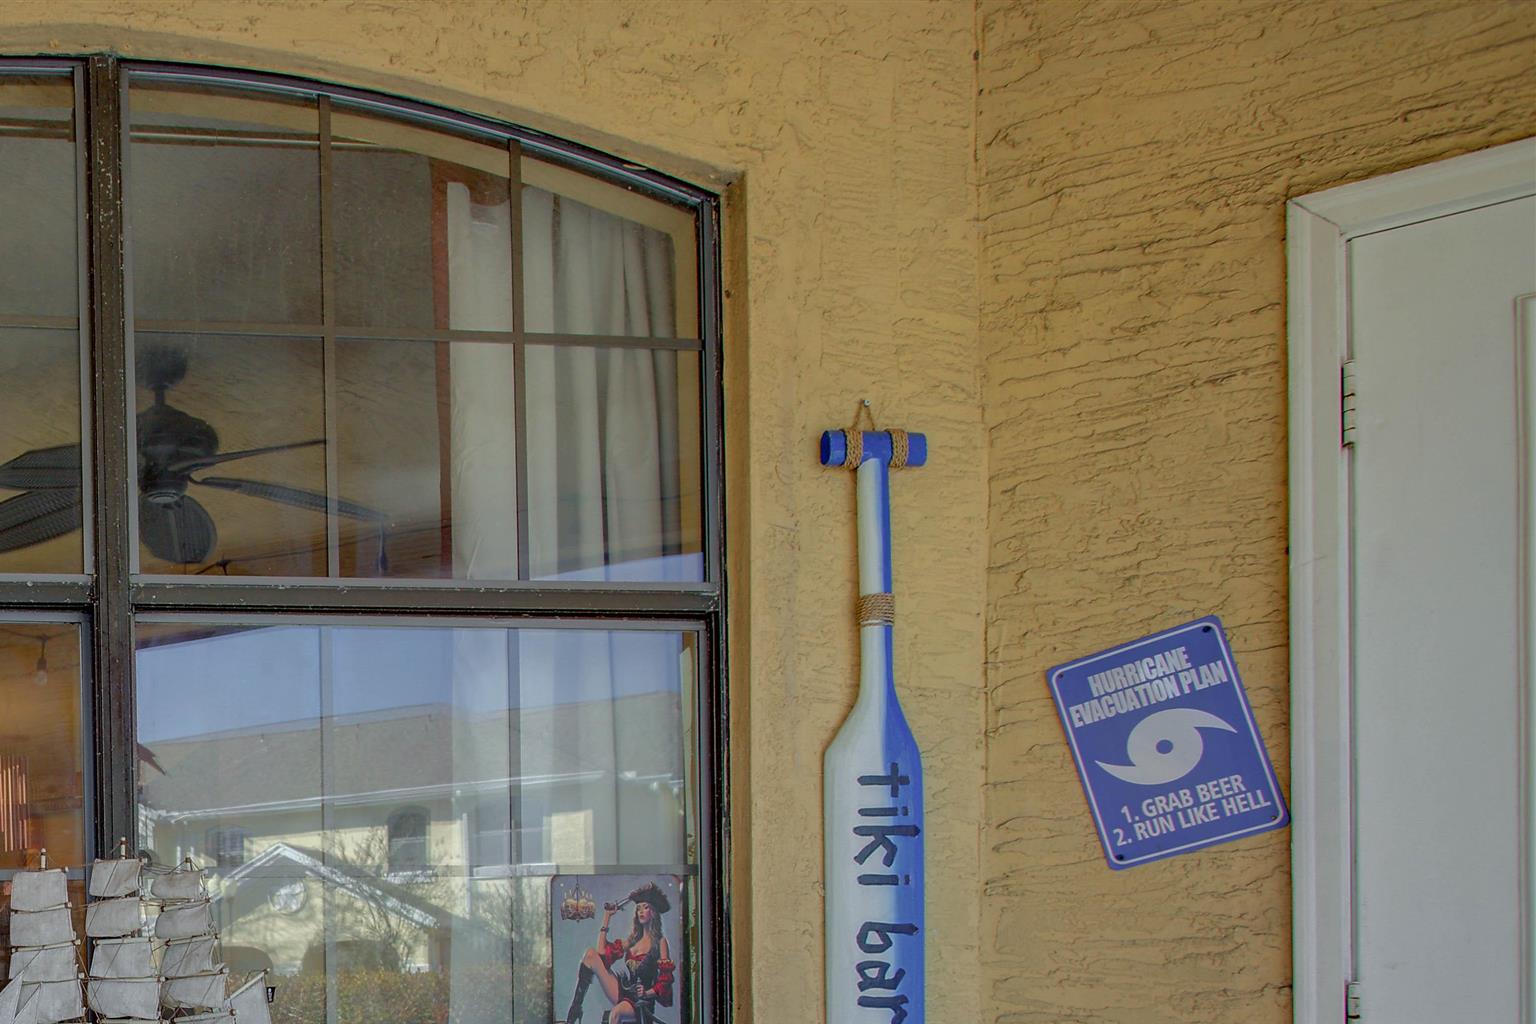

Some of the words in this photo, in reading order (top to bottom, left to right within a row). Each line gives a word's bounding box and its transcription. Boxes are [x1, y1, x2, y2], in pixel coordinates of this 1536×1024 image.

[1068, 676, 1181, 729] EVACUATION
[1179, 660, 1229, 694] PLAN
[1087, 646, 1192, 698] HURRICANE
[852, 762, 921, 889] tiki
[1112, 828, 1133, 847] 2.
[1133, 815, 1176, 842] RUN
[1178, 801, 1221, 829] LIKE
[1222, 789, 1272, 817] HELL
[1120, 804, 1140, 824] 1.
[1141, 789, 1194, 818] GRAB
[1195, 773, 1247, 802] BEER
